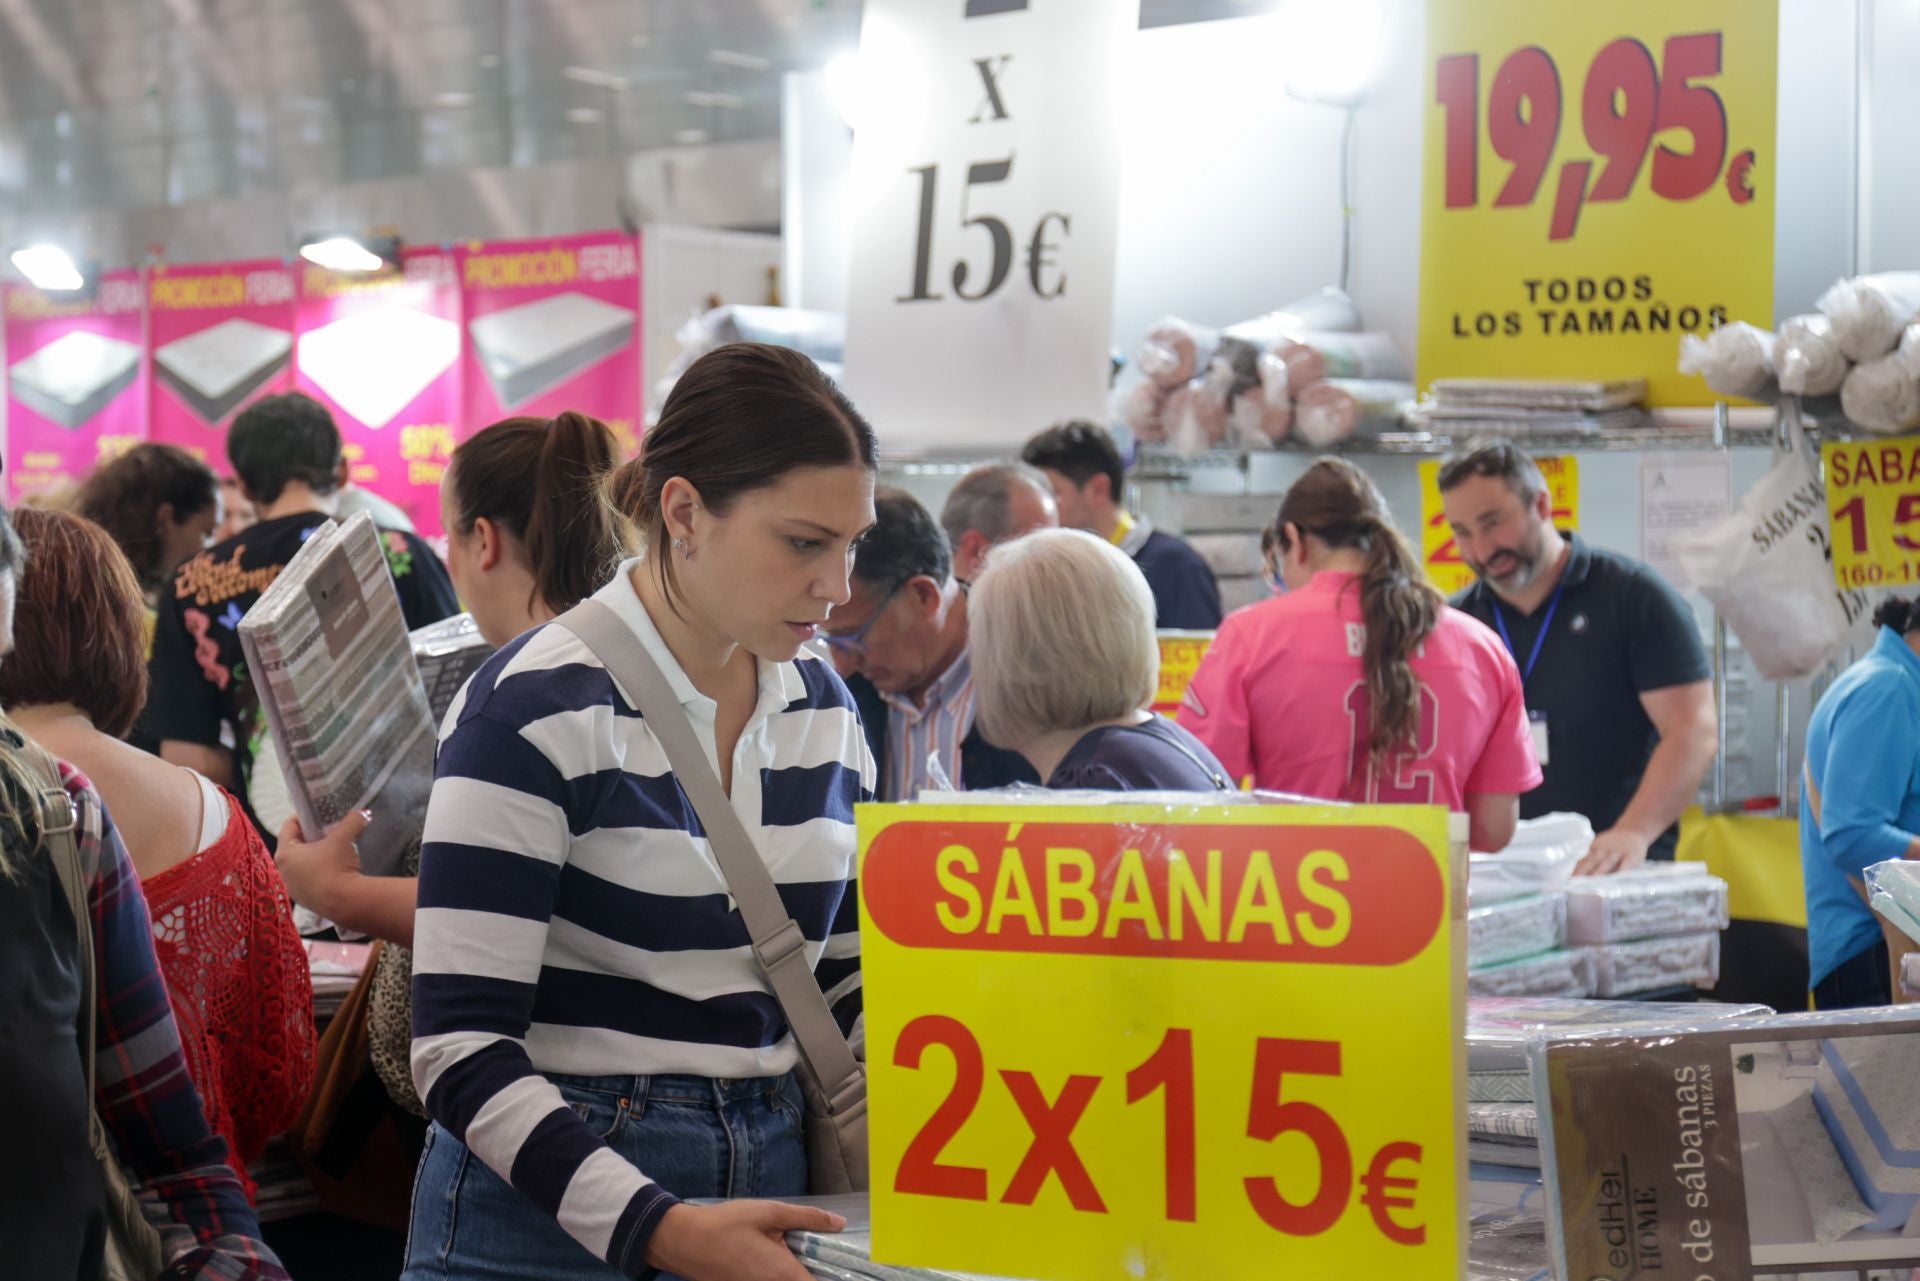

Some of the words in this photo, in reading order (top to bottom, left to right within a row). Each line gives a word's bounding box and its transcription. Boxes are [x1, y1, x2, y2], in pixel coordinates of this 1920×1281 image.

[893, 149, 1071, 304] 15€
[1453, 312, 1522, 338] LOS
[1538, 299, 1729, 336] TAMAÑOS
[1524, 275, 1655, 305] TODOS
[935, 823, 1353, 948] SÁBANAS
[891, 1014, 1428, 1247] 2x15€
[1699, 1063, 1716, 1116] PIEZAS
[1673, 1066, 1710, 1208] sábanas
[1596, 1167, 1630, 1272] edHer
[1634, 1187, 1663, 1271] HOME
[1682, 1218, 1714, 1264] de
